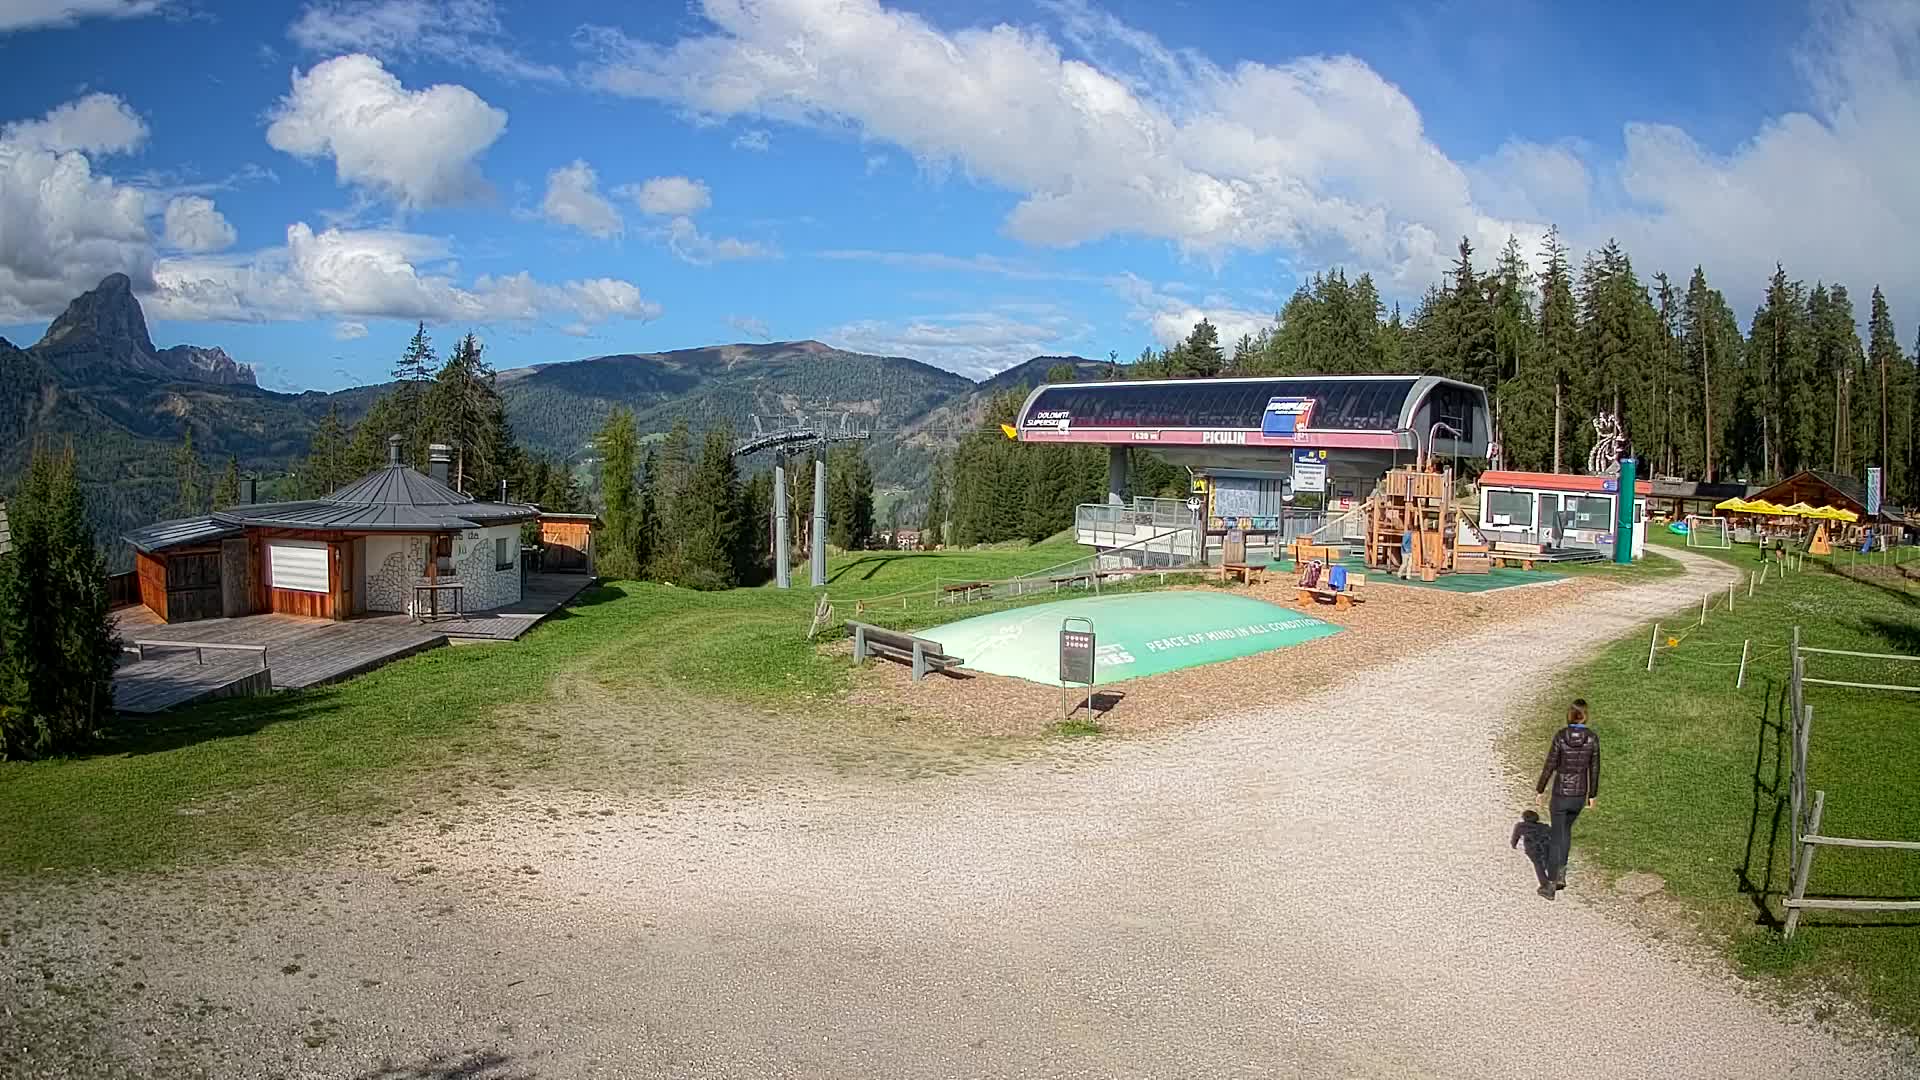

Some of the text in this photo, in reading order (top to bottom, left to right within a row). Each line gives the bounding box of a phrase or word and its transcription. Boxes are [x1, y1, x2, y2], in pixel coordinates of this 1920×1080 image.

[1037, 411, 1069, 419] DOLOMITI
[1202, 431, 1246, 444] PICULIN
[1145, 637, 1190, 653] PEACE
[1189, 633, 1206, 644] OF
[1206, 629, 1234, 641] MIND
[1234, 627, 1250, 637] IN
[1250, 624, 1269, 634] ALL
